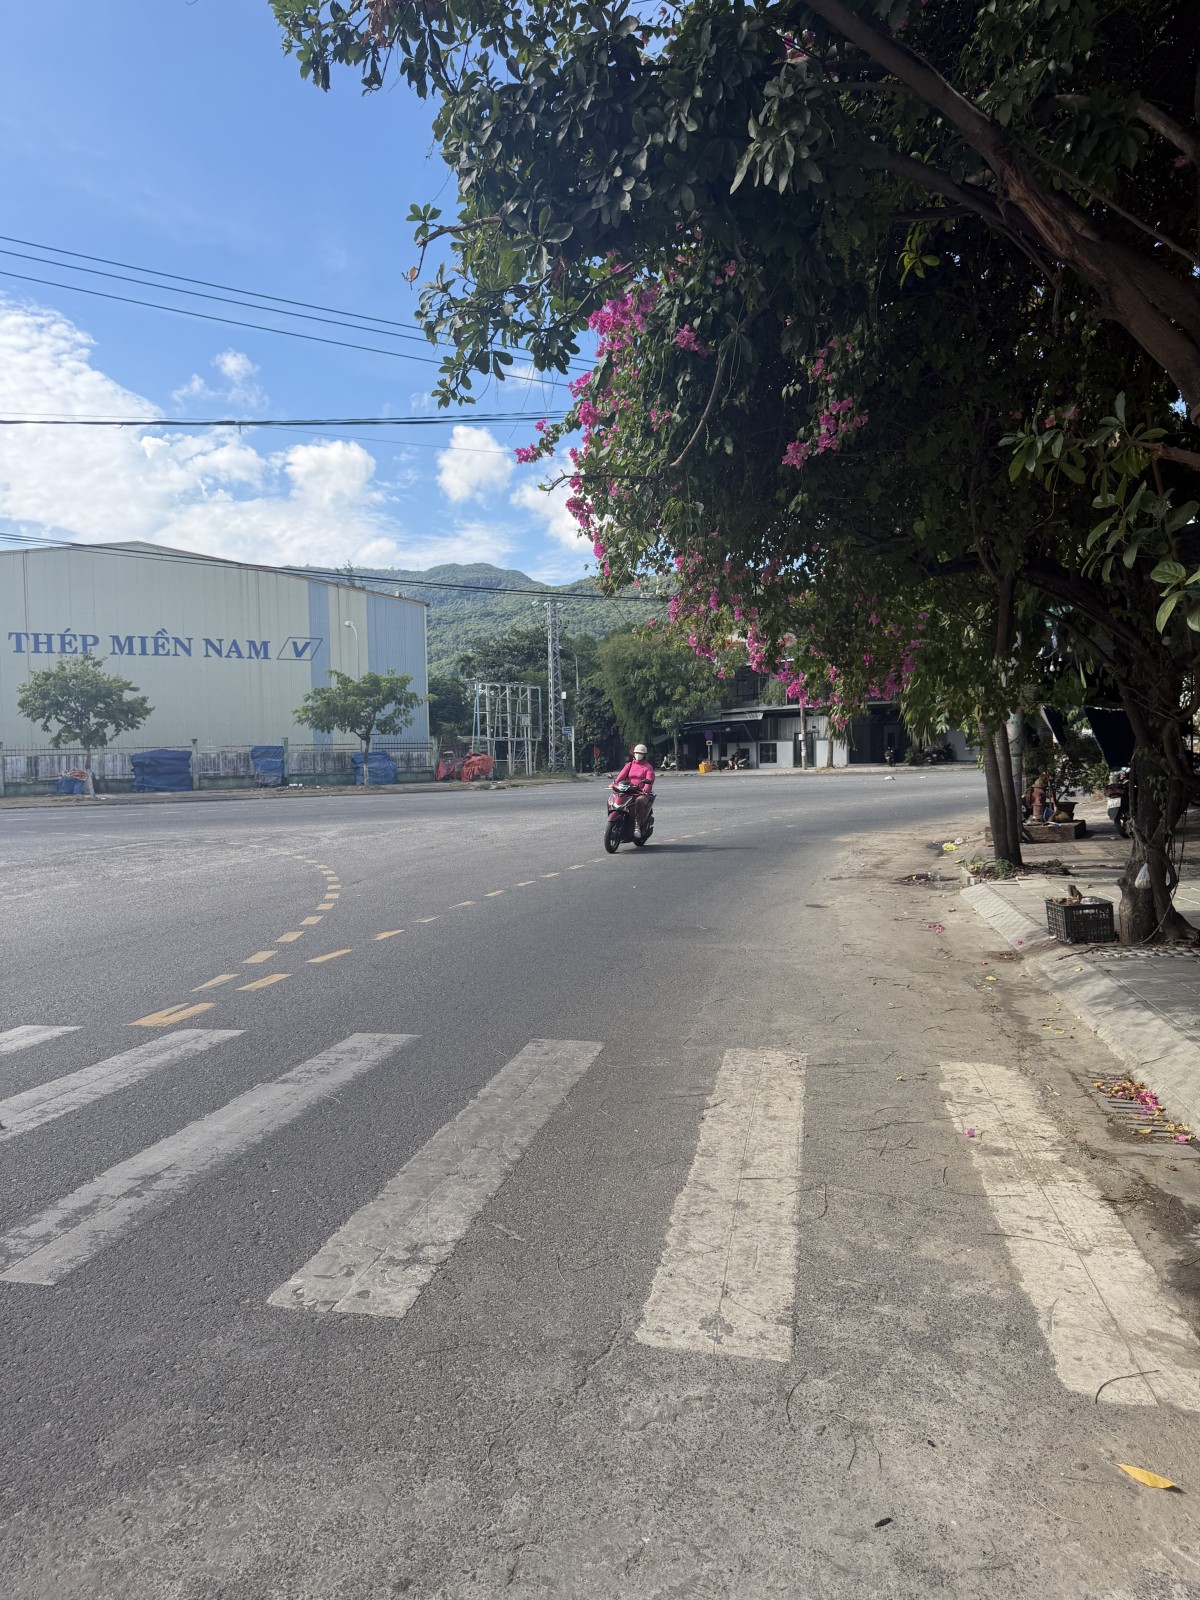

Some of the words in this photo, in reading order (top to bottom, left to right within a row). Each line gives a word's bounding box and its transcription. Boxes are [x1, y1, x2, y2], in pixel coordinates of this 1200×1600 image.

[8, 628, 100, 654] THÉP
[109, 628, 194, 657] MIỀN
[202, 638, 271, 660] NAM
